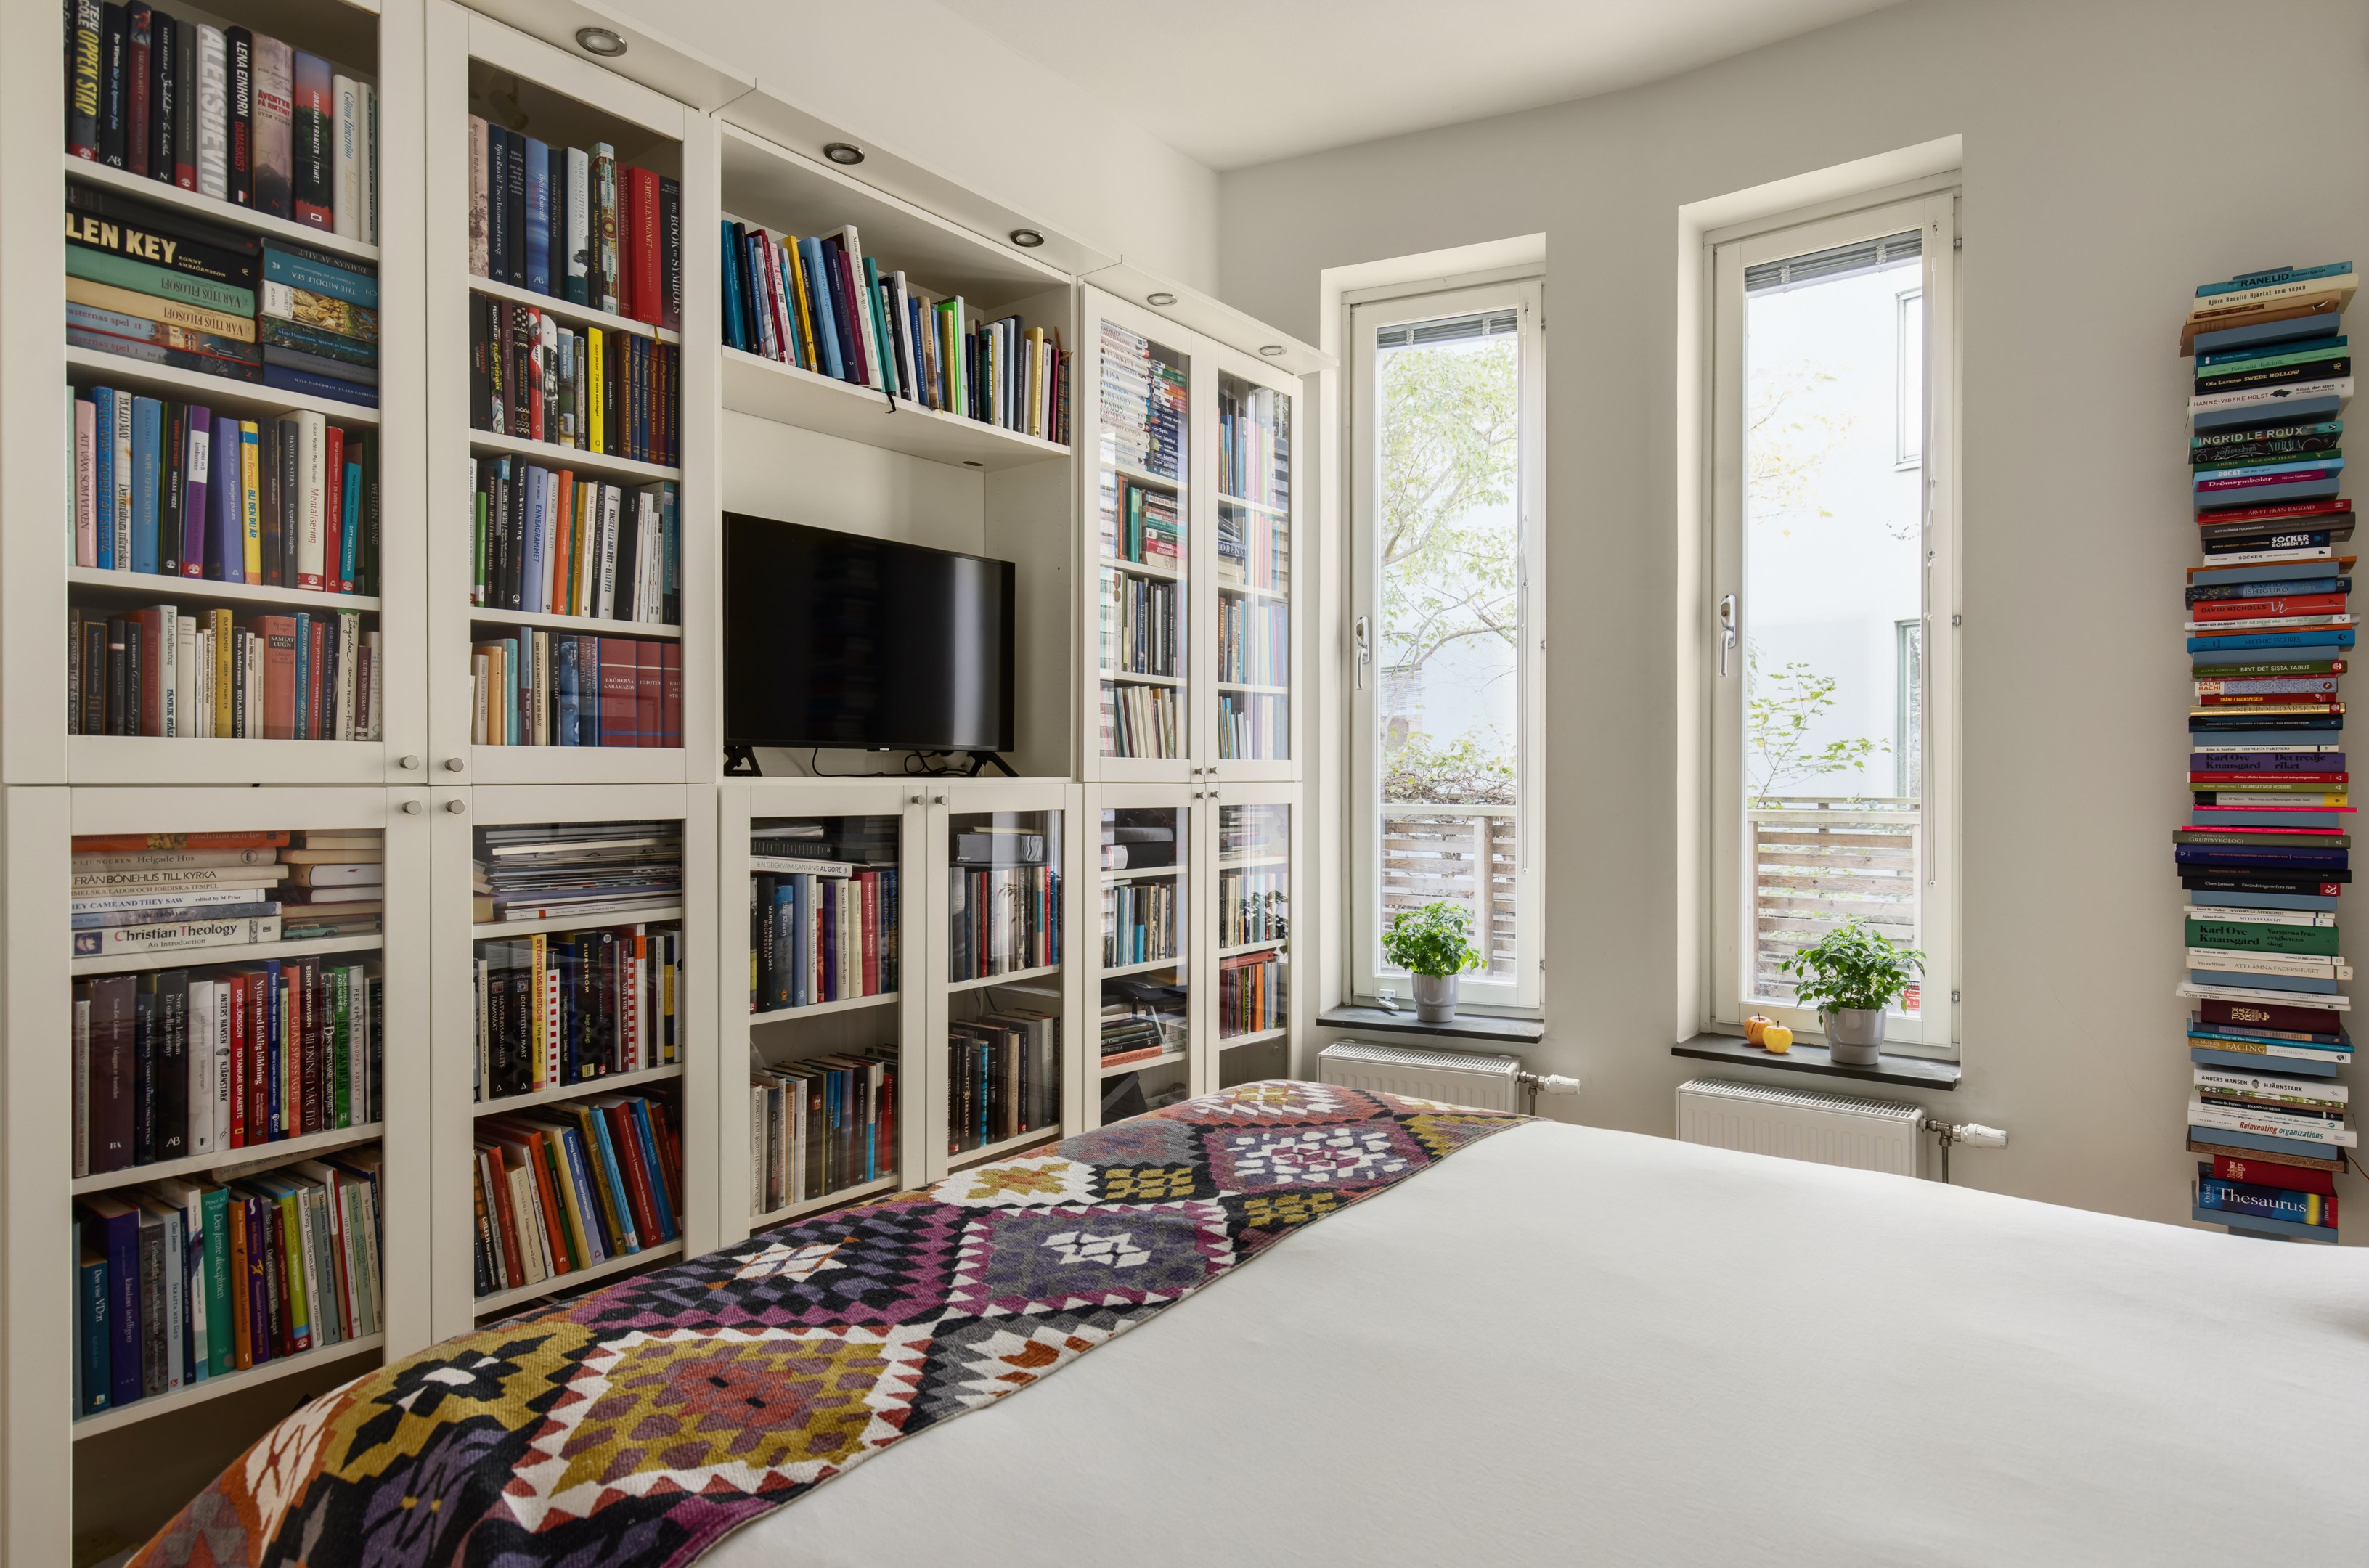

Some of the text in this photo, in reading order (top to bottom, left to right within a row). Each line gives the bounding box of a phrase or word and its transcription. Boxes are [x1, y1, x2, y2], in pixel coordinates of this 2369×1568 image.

[78, 0, 89, 26] COLE
[90, 5, 99, 32] TEJU
[76, 82, 97, 115] STAD
[234, 41, 248, 172] LENA EINHORN DAMASKUS?
[343, 92, 356, 159] Göran Tunström
[670, 215, 679, 248] BOOK
[126, 229, 176, 264] KEY
[178, 262, 226, 277] AMBJÖRNSSON
[179, 256, 201, 265] RONNY
[161, 279, 200, 297] FILOSOFI
[307, 277, 338, 291] MIDDLE
[2240, 273, 2288, 287] RANELID
[203, 290, 221, 303] TIDS
[341, 286, 355, 295] THE
[2226, 294, 2247, 303] Ranelid
[2250, 290, 2271, 299] Hjärtat
[163, 307, 203, 325] FILOSOFI
[205, 318, 224, 331] TIDS
[2270, 369, 2300, 378] HOLLOW
[119, 397, 129, 419] ROLLO
[2194, 396, 2245, 407] HANNE-VIBEKE
[119, 420, 129, 440] MAY
[2199, 427, 2304, 446] INGRID LE ROUX
[1163, 453, 1178, 462] London
[80, 431, 90, 529] ATT VÄXA SOM VUXEN
[247, 462, 256, 488] Ferrucci
[2209, 477, 2272, 487] Drömsymboler
[118, 484, 129, 497] Den
[249, 518, 256, 526] DU
[309, 488, 319, 543] Mentalisering
[250, 528, 257, 538] ÄR
[533, 505, 542, 563] ENNEAGRAMMET
[118, 531, 129, 568] människan
[74, 873, 105, 885] FRÅN
[106, 873, 160, 883] BÖNEHUS
[183, 870, 216, 880] KYRKA
[114, 923, 237, 942] Christian Theology
[2199, 926, 2247, 935] Karl Ove
[160, 938, 205, 947] Introduction
[255, 980, 264, 1005] Nyttan
[219, 993, 228, 1102] ANDERS HANSEN HJÄRNSTARK
[255, 1026, 265, 1051] folklig
[2226, 1042, 2265, 1053] FACING
[304, 1033, 316, 1078] BILDNING
[255, 1053, 265, 1085] bildning
[2264, 1082, 2302, 1092] HJÄRNSTARK
[306, 1108, 315, 1126] TID
[2240, 1122, 2323, 1139] Reinventing organizations
[2216, 1187, 2307, 1212] Thesaurus
[482, 1217, 491, 1243] CHEFEN
[213, 1214, 226, 1298] Den femte disciplinen
